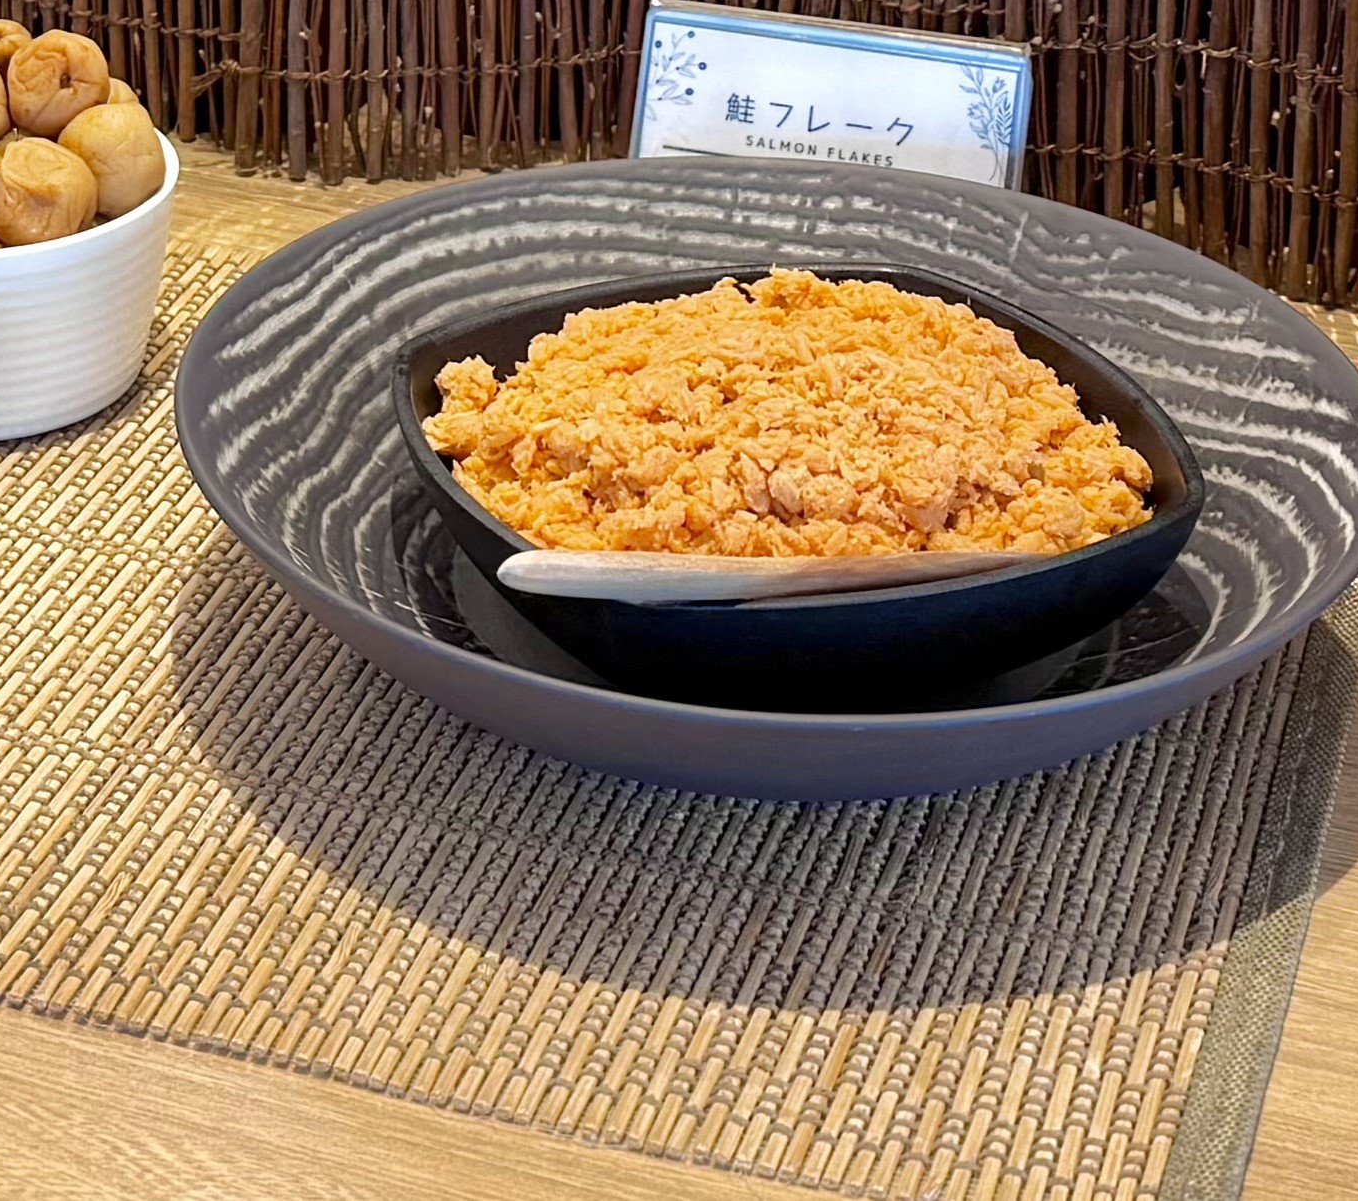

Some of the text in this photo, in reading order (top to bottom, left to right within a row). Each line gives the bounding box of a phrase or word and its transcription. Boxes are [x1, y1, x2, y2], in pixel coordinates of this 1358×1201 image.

[725, 92, 914, 146] 鮭フレーク
[745, 135, 894, 167] SALMON FLAKES
